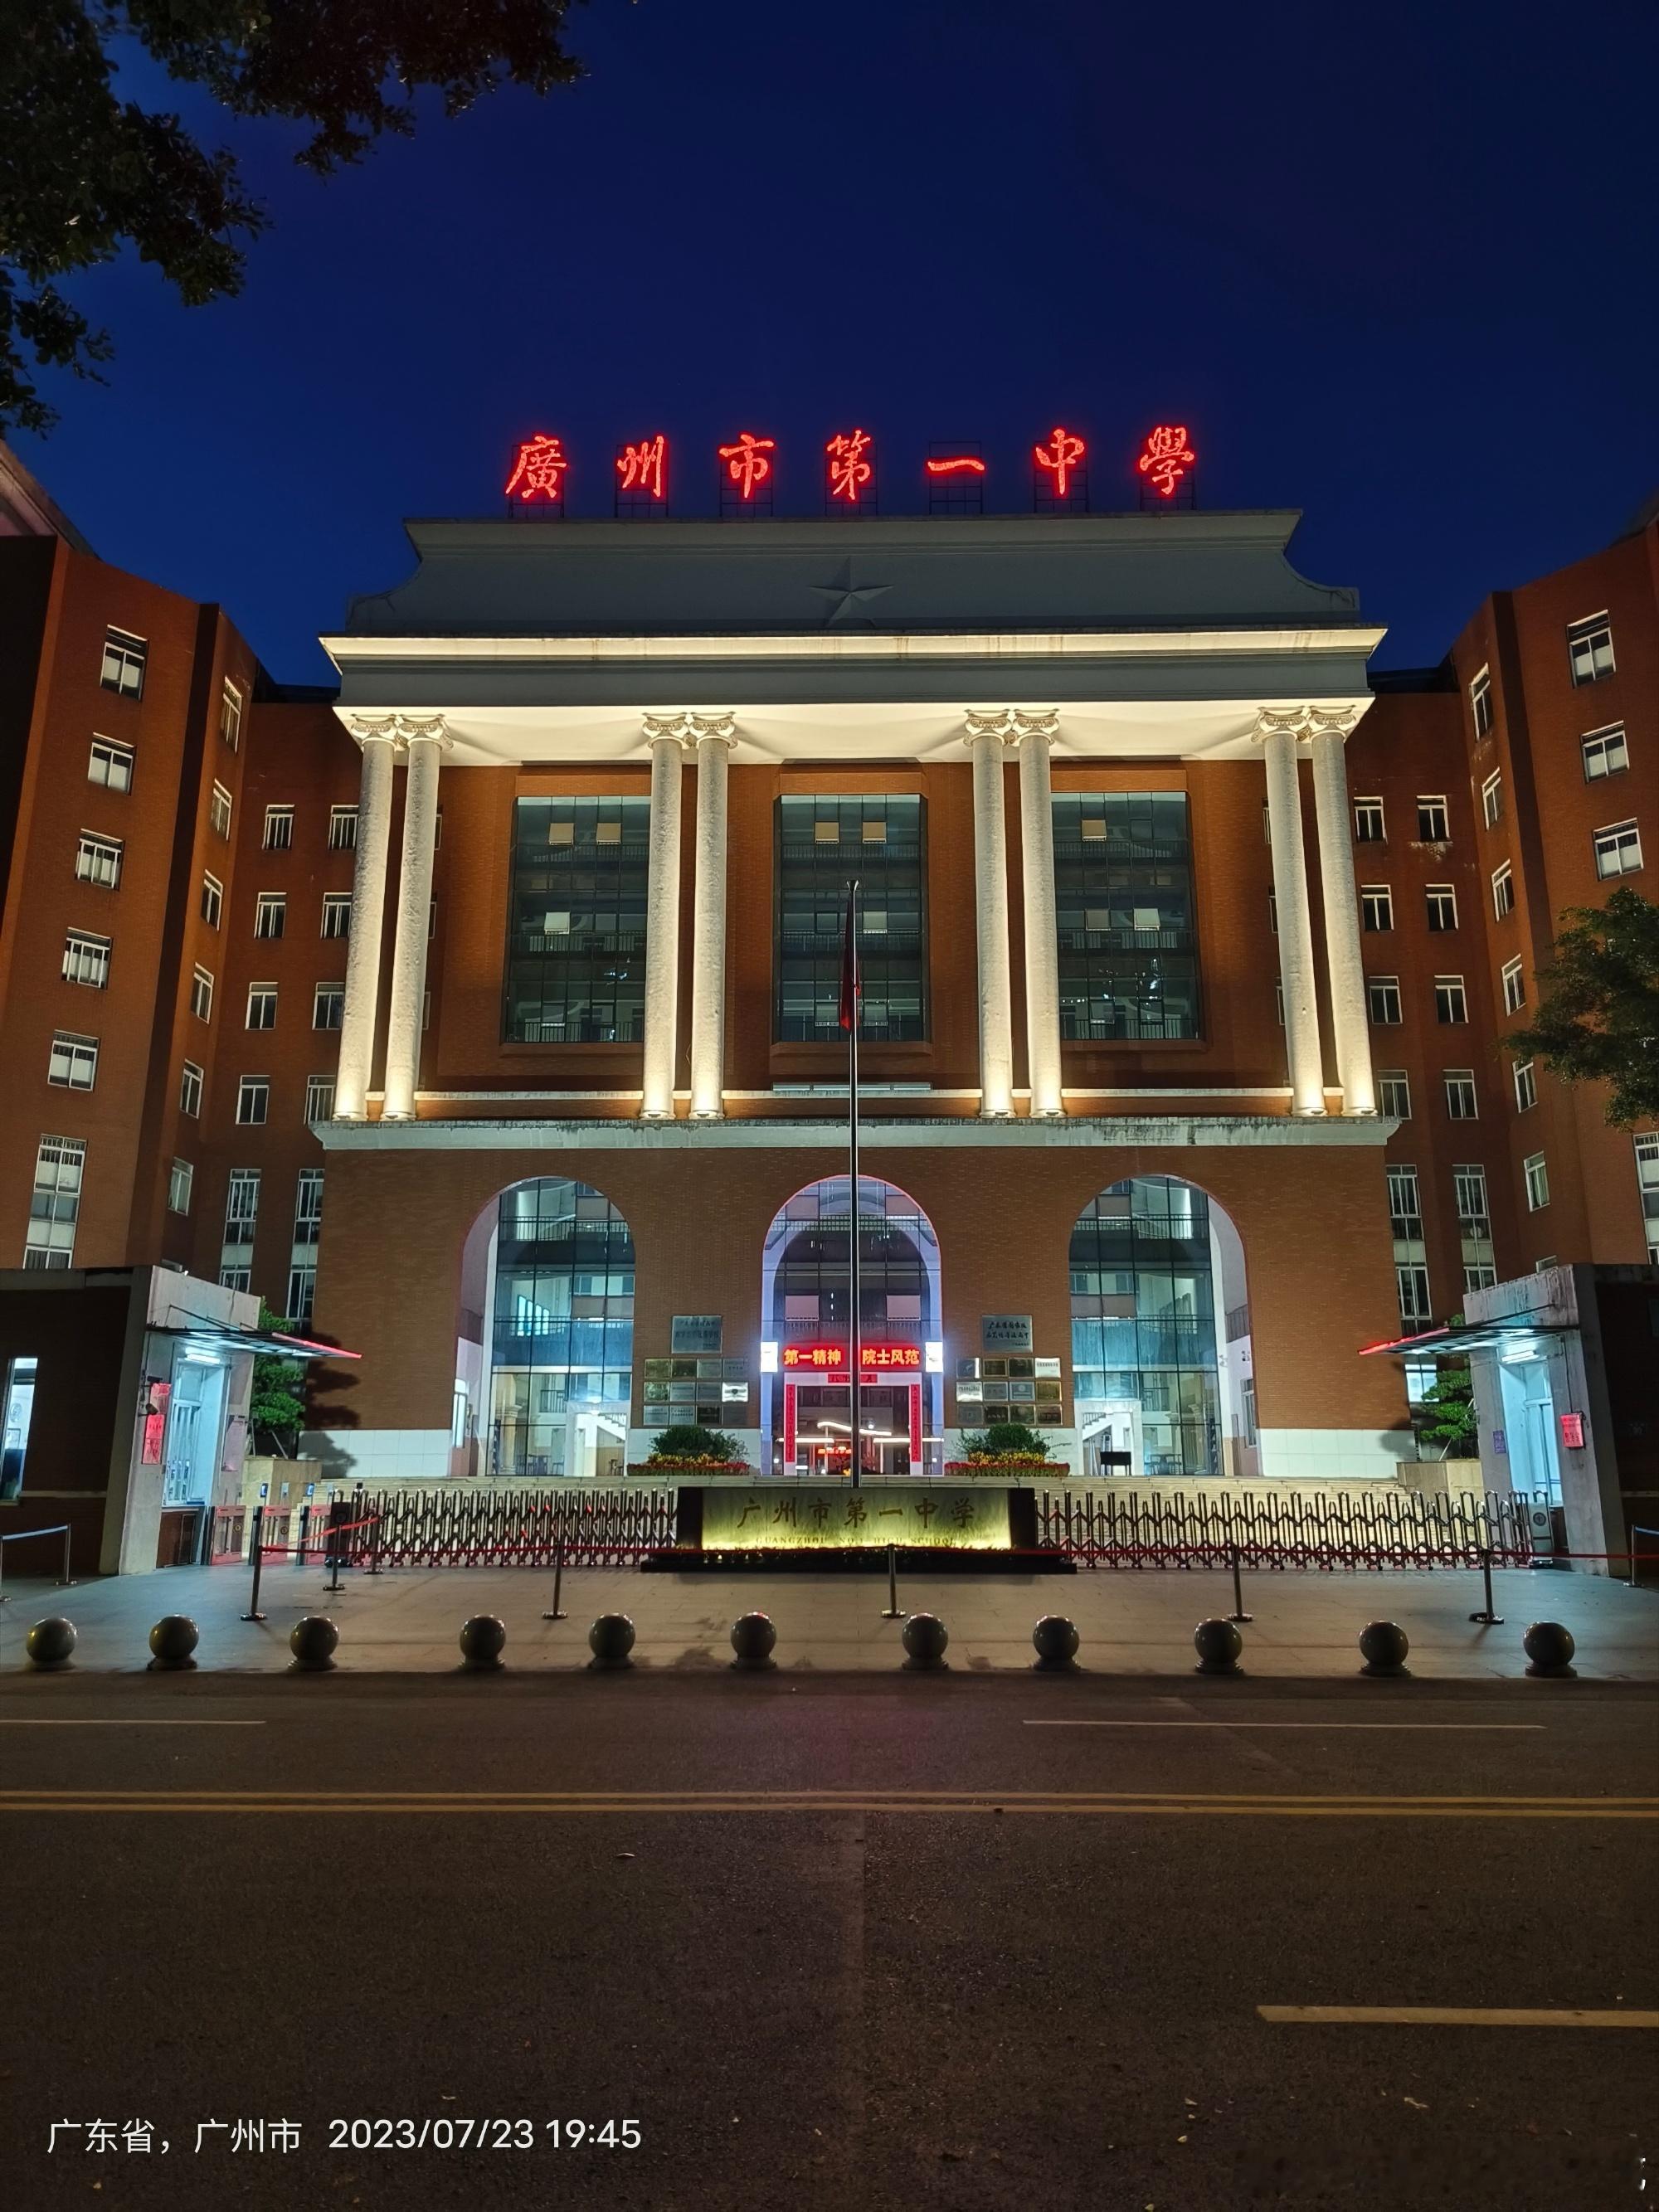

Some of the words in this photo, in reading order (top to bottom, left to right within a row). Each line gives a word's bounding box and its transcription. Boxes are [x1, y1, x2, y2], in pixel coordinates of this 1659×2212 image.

[505, 427, 1195, 500] 廣州市第一中學
[784, 1349, 841, 1365] 第一精神
[862, 1349, 920, 1365] 院士风范
[737, 1496, 975, 1529] 广州市第一中学
